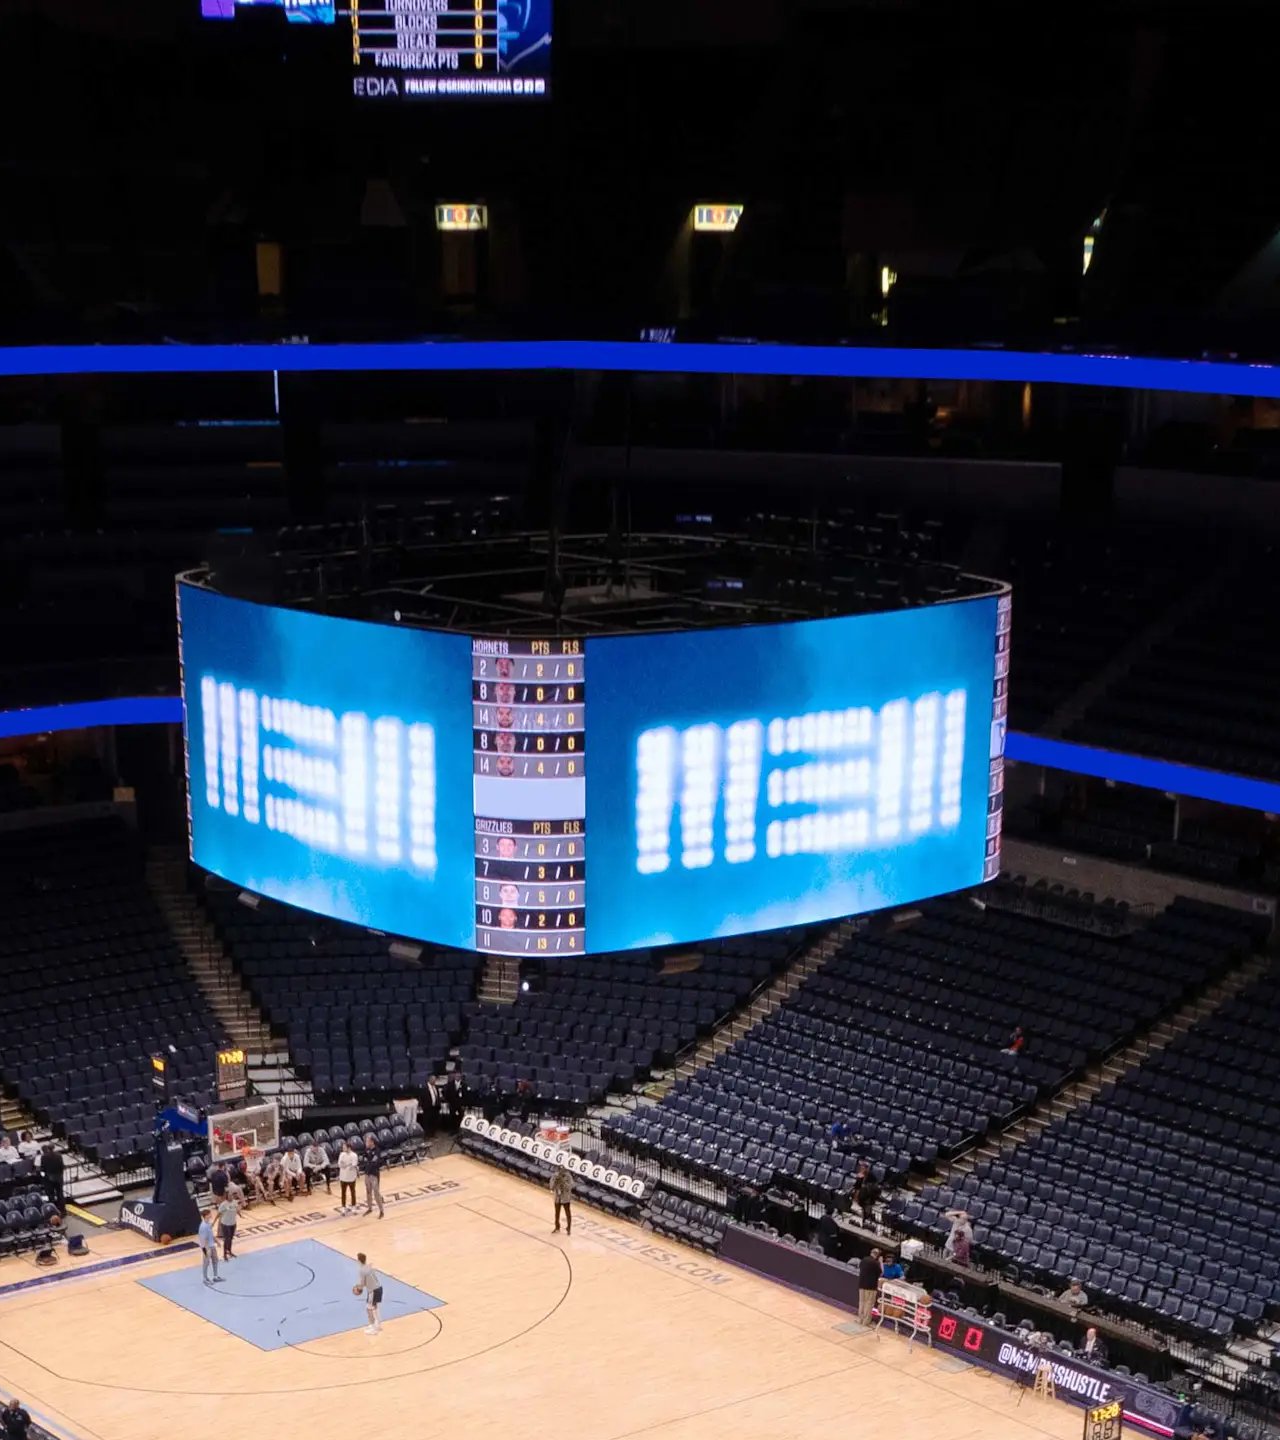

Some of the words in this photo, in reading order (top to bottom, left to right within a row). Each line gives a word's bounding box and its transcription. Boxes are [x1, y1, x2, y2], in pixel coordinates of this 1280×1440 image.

[385, 0, 448, 11] TURNOVERS
[395, 15, 438, 30] BLOCKS
[396, 34, 436, 49] STEALS
[438, 54, 459, 69] PTS
[405, 79, 437, 93] FOLLOW
[473, 640, 509, 654] HORNETS
[531, 641, 550, 655] PTS
[563, 641, 579, 655] FLS
[480, 660, 487, 676] 2
[536, 664, 544, 677] 2
[567, 662, 575, 677] 0
[480, 683, 487, 700] 8
[536, 687, 544, 701] 0
[567, 687, 575, 700] 0
[480, 709, 489, 725] 14
[537, 713, 544, 726] 4
[567, 712, 575, 726] 0
[481, 733, 488, 749] 8
[536, 738, 545, 751] 0
[567, 737, 575, 751] 0
[480, 758, 489, 773] 14
[537, 762, 544, 775] 4
[568, 761, 575, 775] 0
[475, 819, 513, 834] GRIZZLIES
[533, 822, 551, 835] PTS
[563, 821, 580, 834] FLS
[482, 838, 489, 853] 3
[538, 843, 545, 856] 0
[568, 842, 575, 855] 0
[483, 862, 489, 876] 7
[538, 866, 545, 879] 3
[483, 886, 490, 901] 8
[568, 890, 575, 902] 0
[482, 909, 492, 925] 10
[538, 914, 546, 927] 2
[568, 913, 576, 926] 0
[484, 933, 490, 947] 11
[537, 937, 547, 950] 13
[568, 936, 575, 949] 4
[122, 1207, 154, 1237] SPALDING
[233, 1212, 327, 1239] EMPHIS
